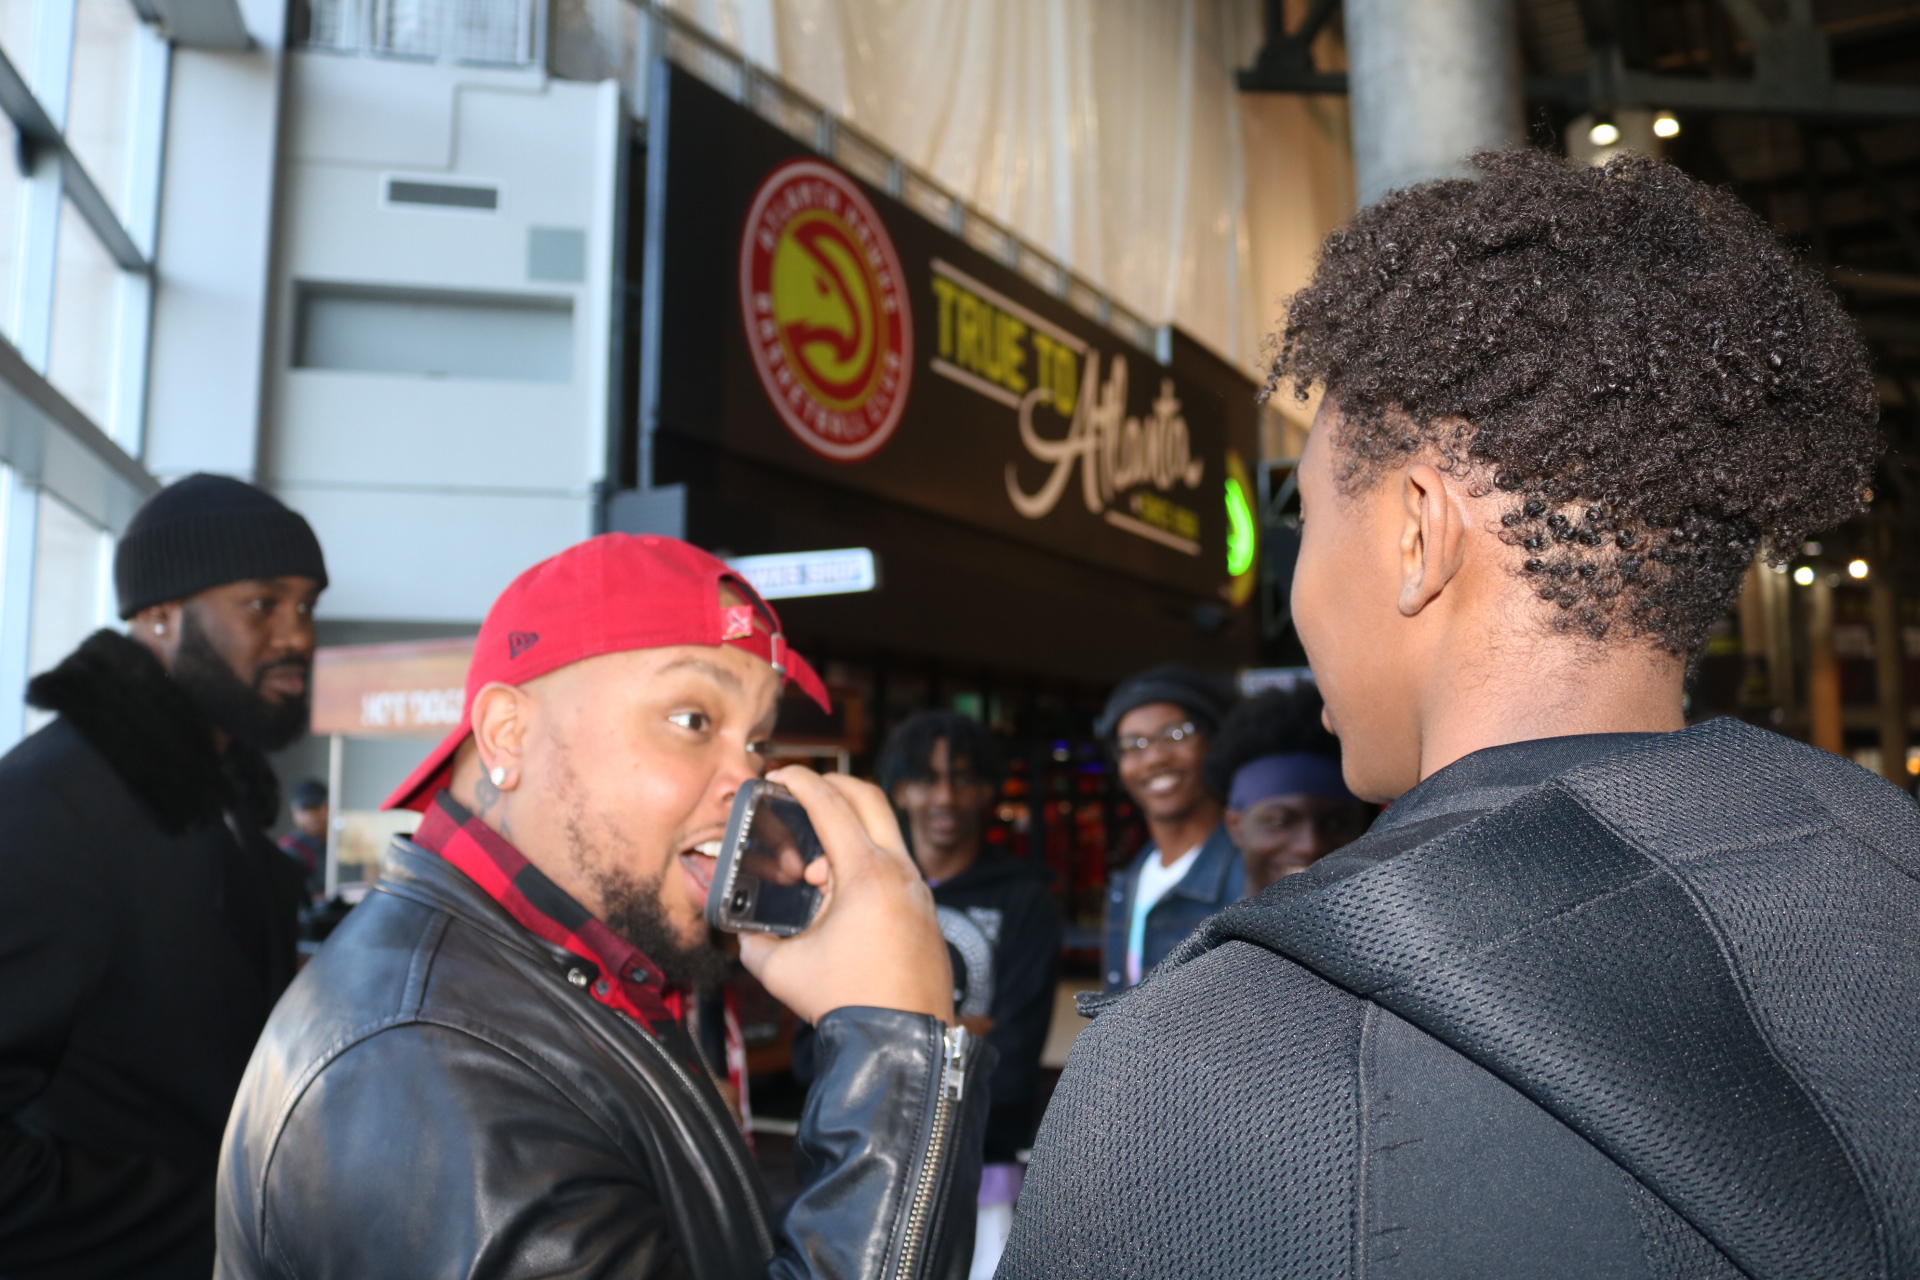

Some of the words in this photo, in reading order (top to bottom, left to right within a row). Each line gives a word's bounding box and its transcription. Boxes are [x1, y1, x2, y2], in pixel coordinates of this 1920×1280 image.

[932, 274, 1027, 394] TRUE
[1033, 331, 1078, 417] TO
[1004, 348, 1204, 519] Atlanta
